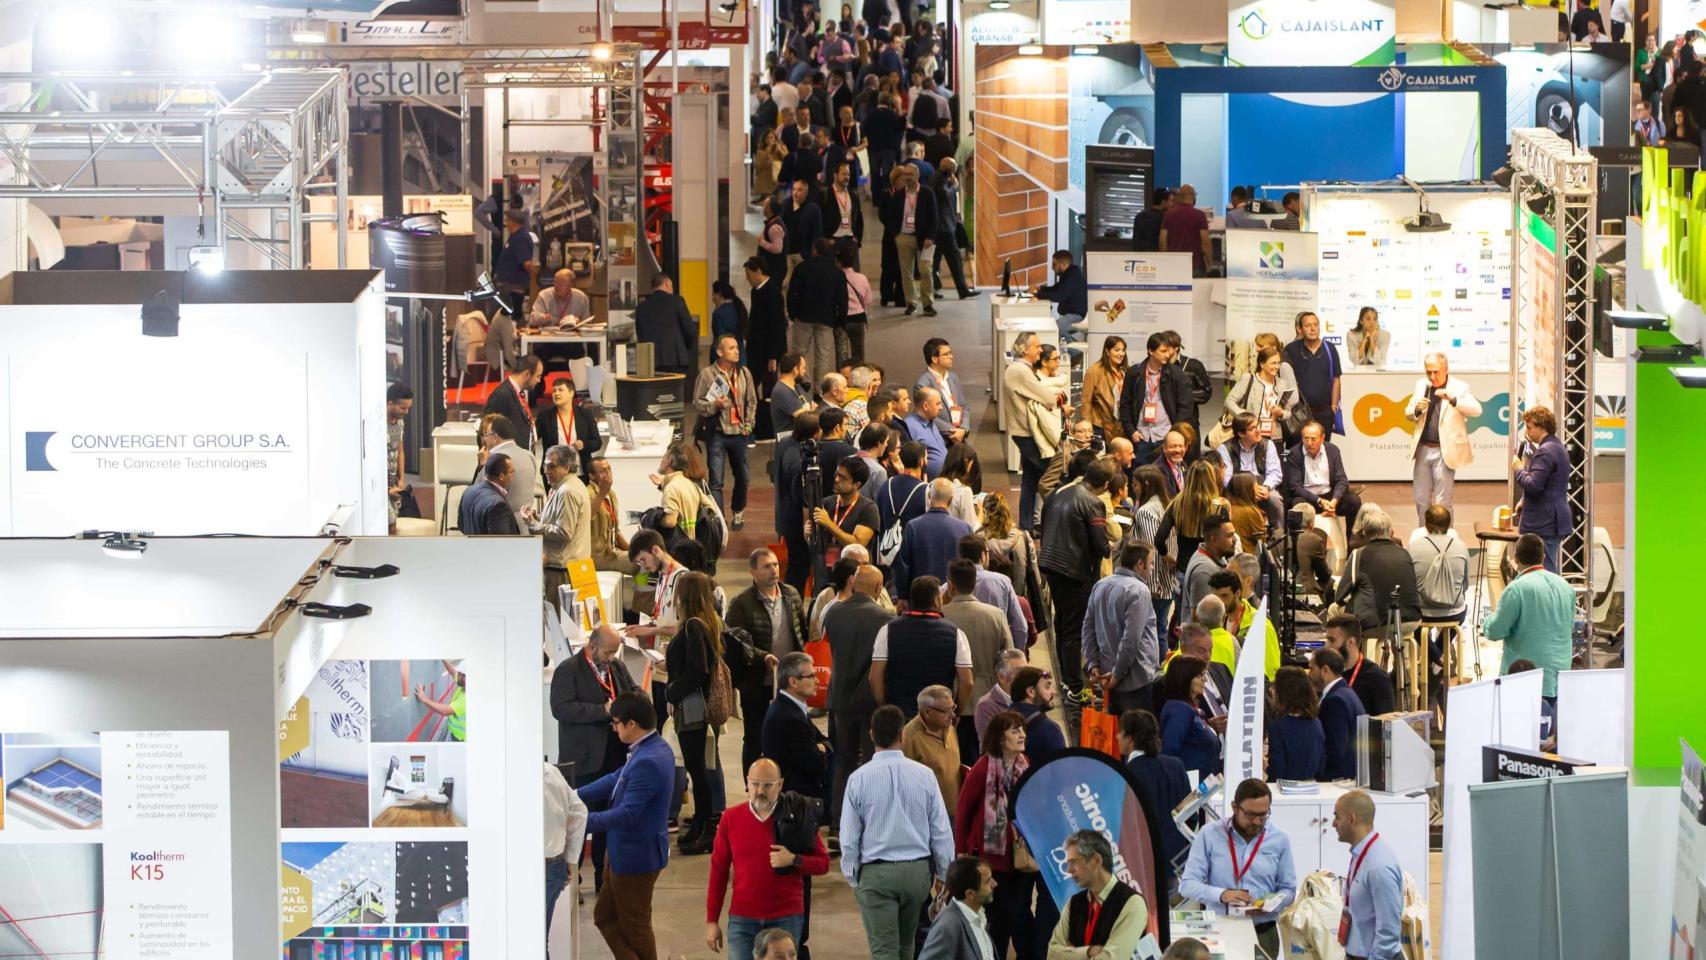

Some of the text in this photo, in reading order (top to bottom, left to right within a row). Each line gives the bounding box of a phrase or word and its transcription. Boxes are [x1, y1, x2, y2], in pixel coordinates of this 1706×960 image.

[1281, 19, 1384, 32] CAJAISLANT
[1406, 75, 1476, 86] CAJAISLANT
[1369, 407, 1383, 423] P
[71, 434, 290, 449] CONVERGENT GROUP S.A.
[1370, 441, 1506, 450] Plataform Español
[96, 457, 267, 471] The Concrete Technologies
[1498, 753, 1564, 778] Panasonic
[130, 850, 185, 861] Kooltherm
[130, 864, 164, 880] K15
